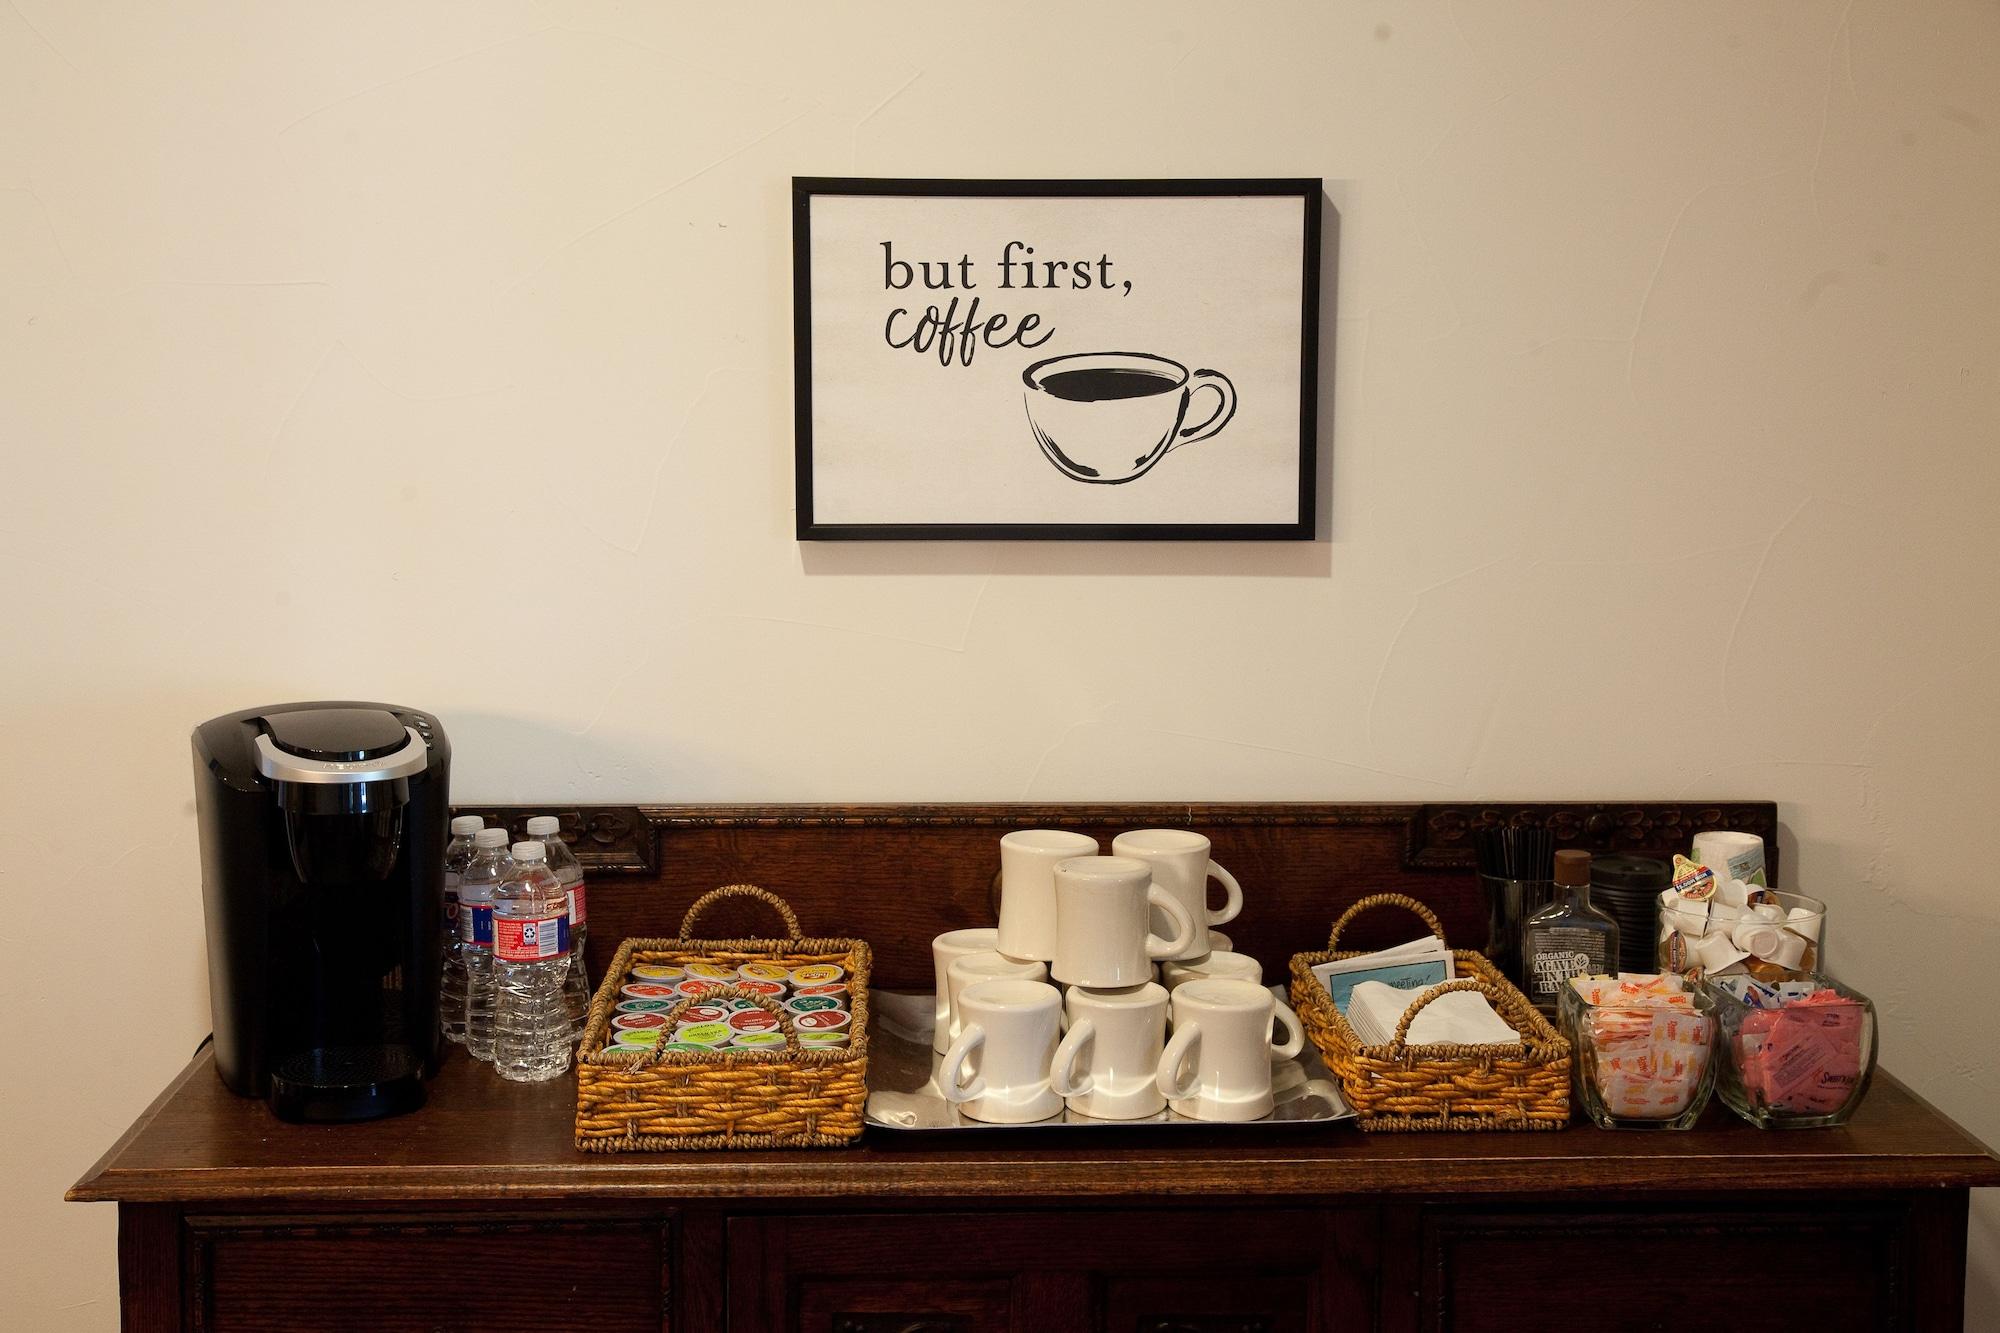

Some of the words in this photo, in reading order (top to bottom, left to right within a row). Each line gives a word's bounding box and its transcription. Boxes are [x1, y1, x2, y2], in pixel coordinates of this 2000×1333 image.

[880, 241, 976, 289] but
[998, 241, 1131, 297] first,
[885, 296, 1056, 367] coffee
[1535, 951, 1575, 961] ORGANIC
[1541, 971, 1558, 984] IN
[1540, 981, 1561, 994] RA
